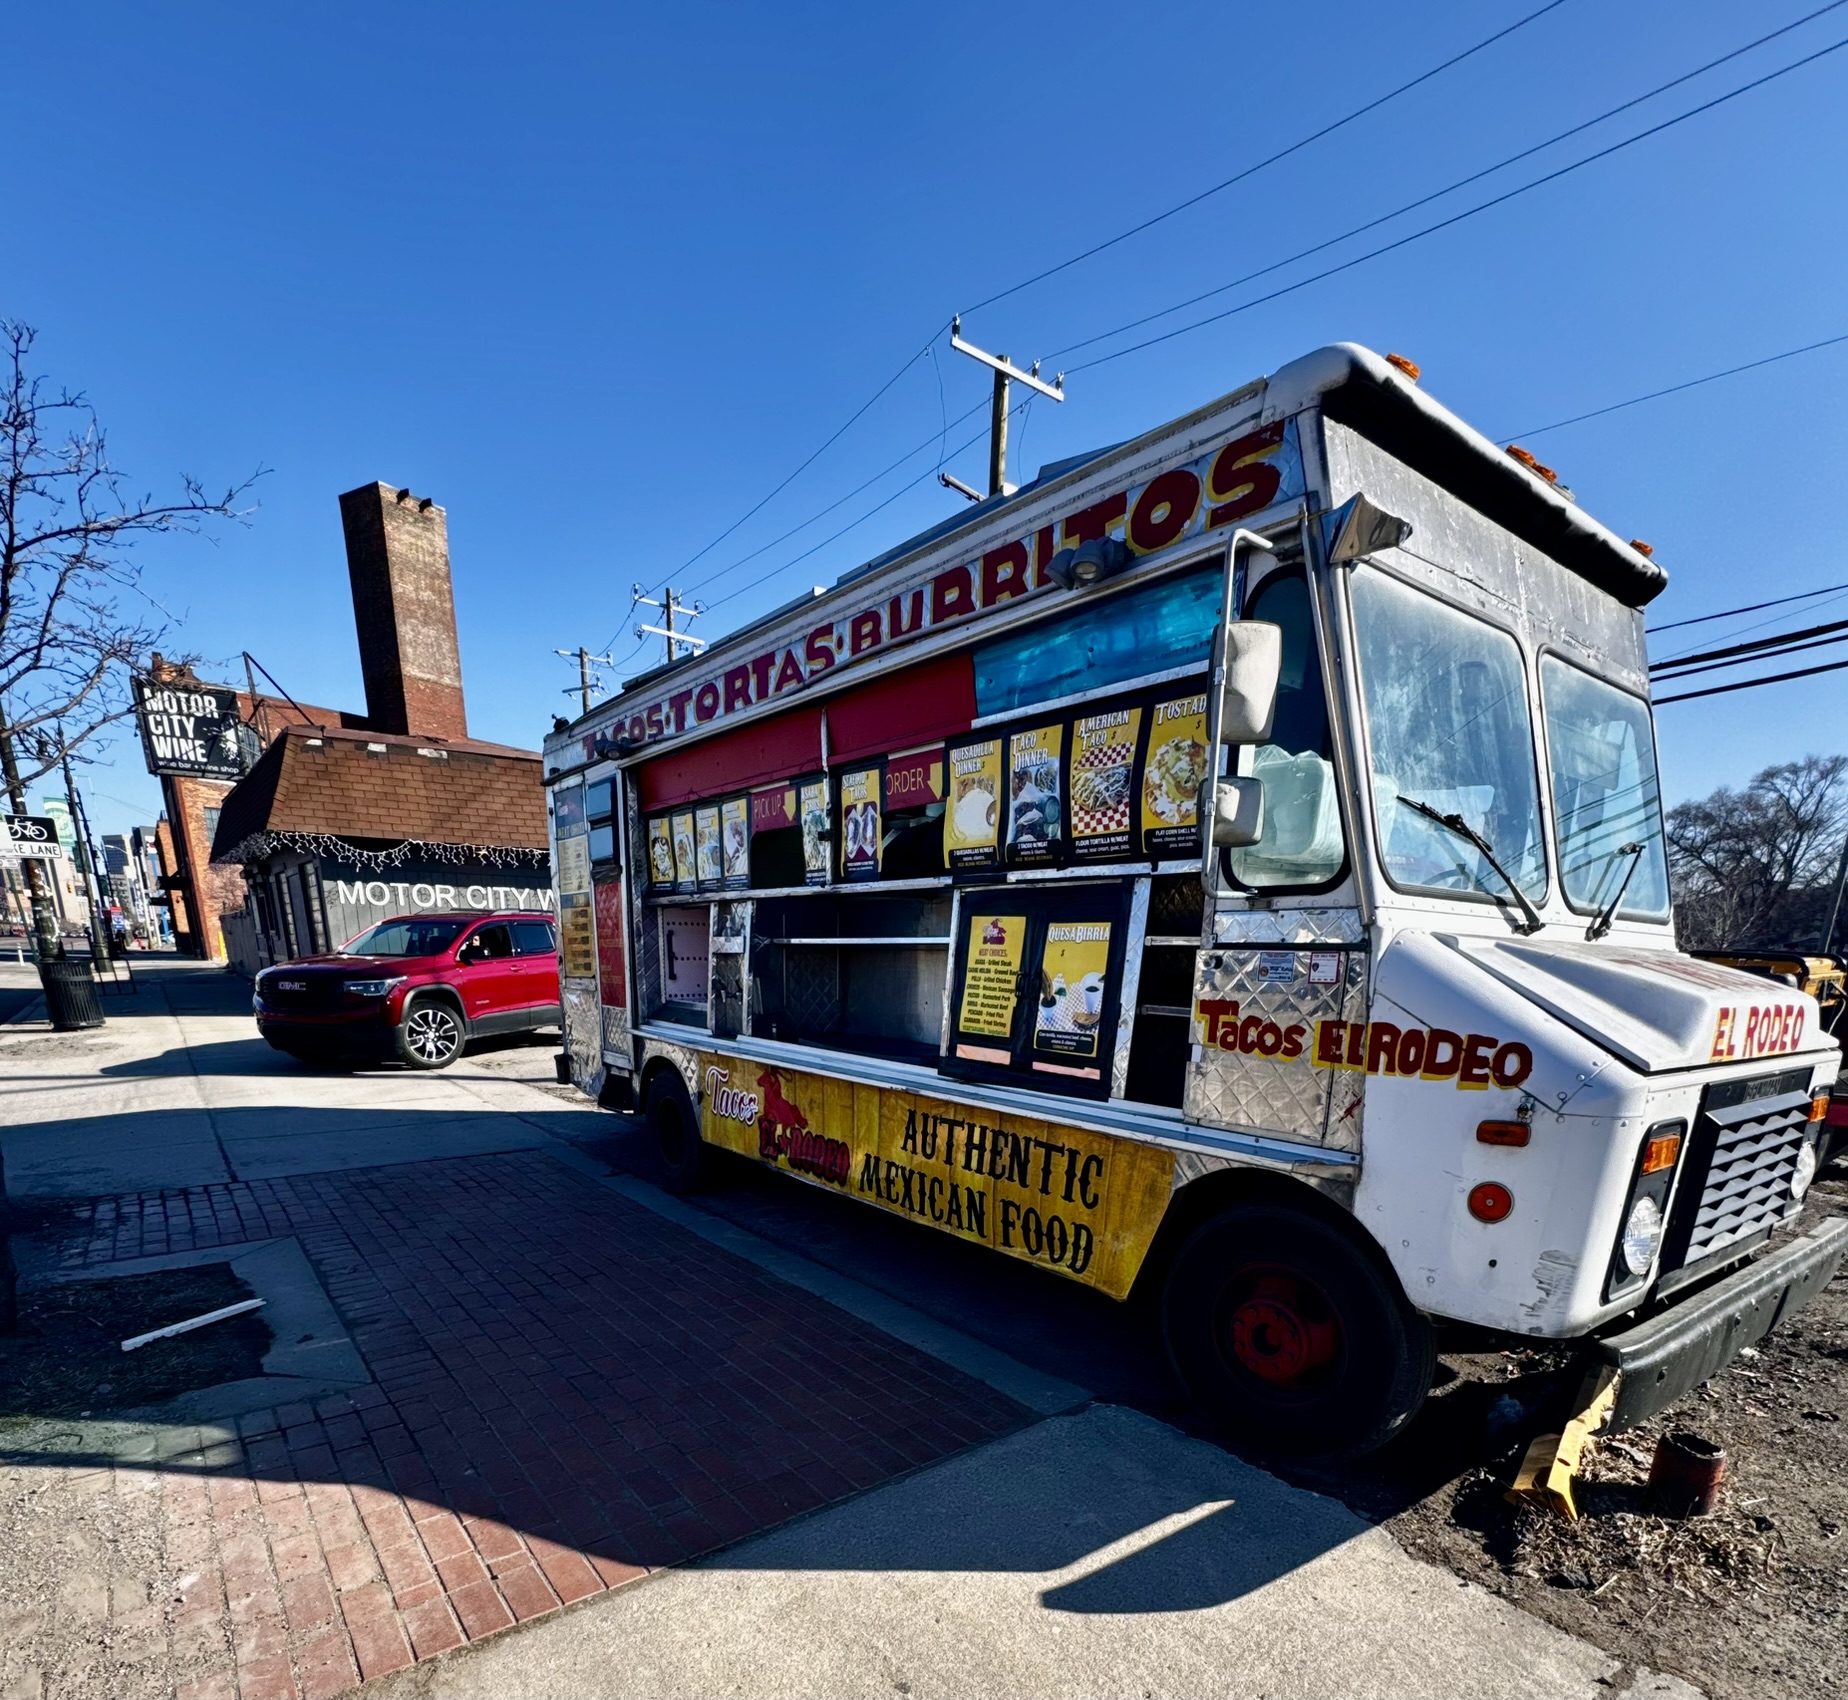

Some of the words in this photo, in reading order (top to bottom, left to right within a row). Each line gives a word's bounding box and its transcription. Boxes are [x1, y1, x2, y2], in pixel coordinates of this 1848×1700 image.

[582, 703, 665, 761] TCOS
[670, 622, 837, 733] TORTAS
[850, 419, 1286, 658] BURRITOS
[143, 688, 219, 719] MOTOR
[148, 714, 195, 739] CITY
[1077, 710, 1130, 737] AMERICAN
[152, 735, 208, 762] WINE
[1011, 733, 1037, 755] TACO
[1080, 730, 1107, 751] TACO
[178, 761, 192, 769] bar
[220, 766, 240, 774] shop
[952, 744, 994, 765] QUESADILLA
[1014, 749, 1049, 772] DINNER
[886, 767, 925, 795] ORDER
[955, 759, 981, 779] DINNER
[754, 799, 771, 818] PICK
[772, 795, 783, 815] UP
[30, 845, 60, 856] LANE
[337, 880, 458, 908] MOTOR
[466, 885, 530, 910] CITY
[1048, 926, 1110, 944] QUESABIRRIA
[1710, 1007, 1737, 1062] EL
[1742, 1004, 1805, 1058] RODEO
[1366, 1022, 1534, 1091] RODEO
[706, 1066, 759, 1125] Tacos
[788, 1127, 850, 1187] RODEO
[901, 1109, 1104, 1209] AUTHENTIC
[858, 1152, 987, 1239] MEXICAN
[1000, 1198, 1094, 1274] FOOD
